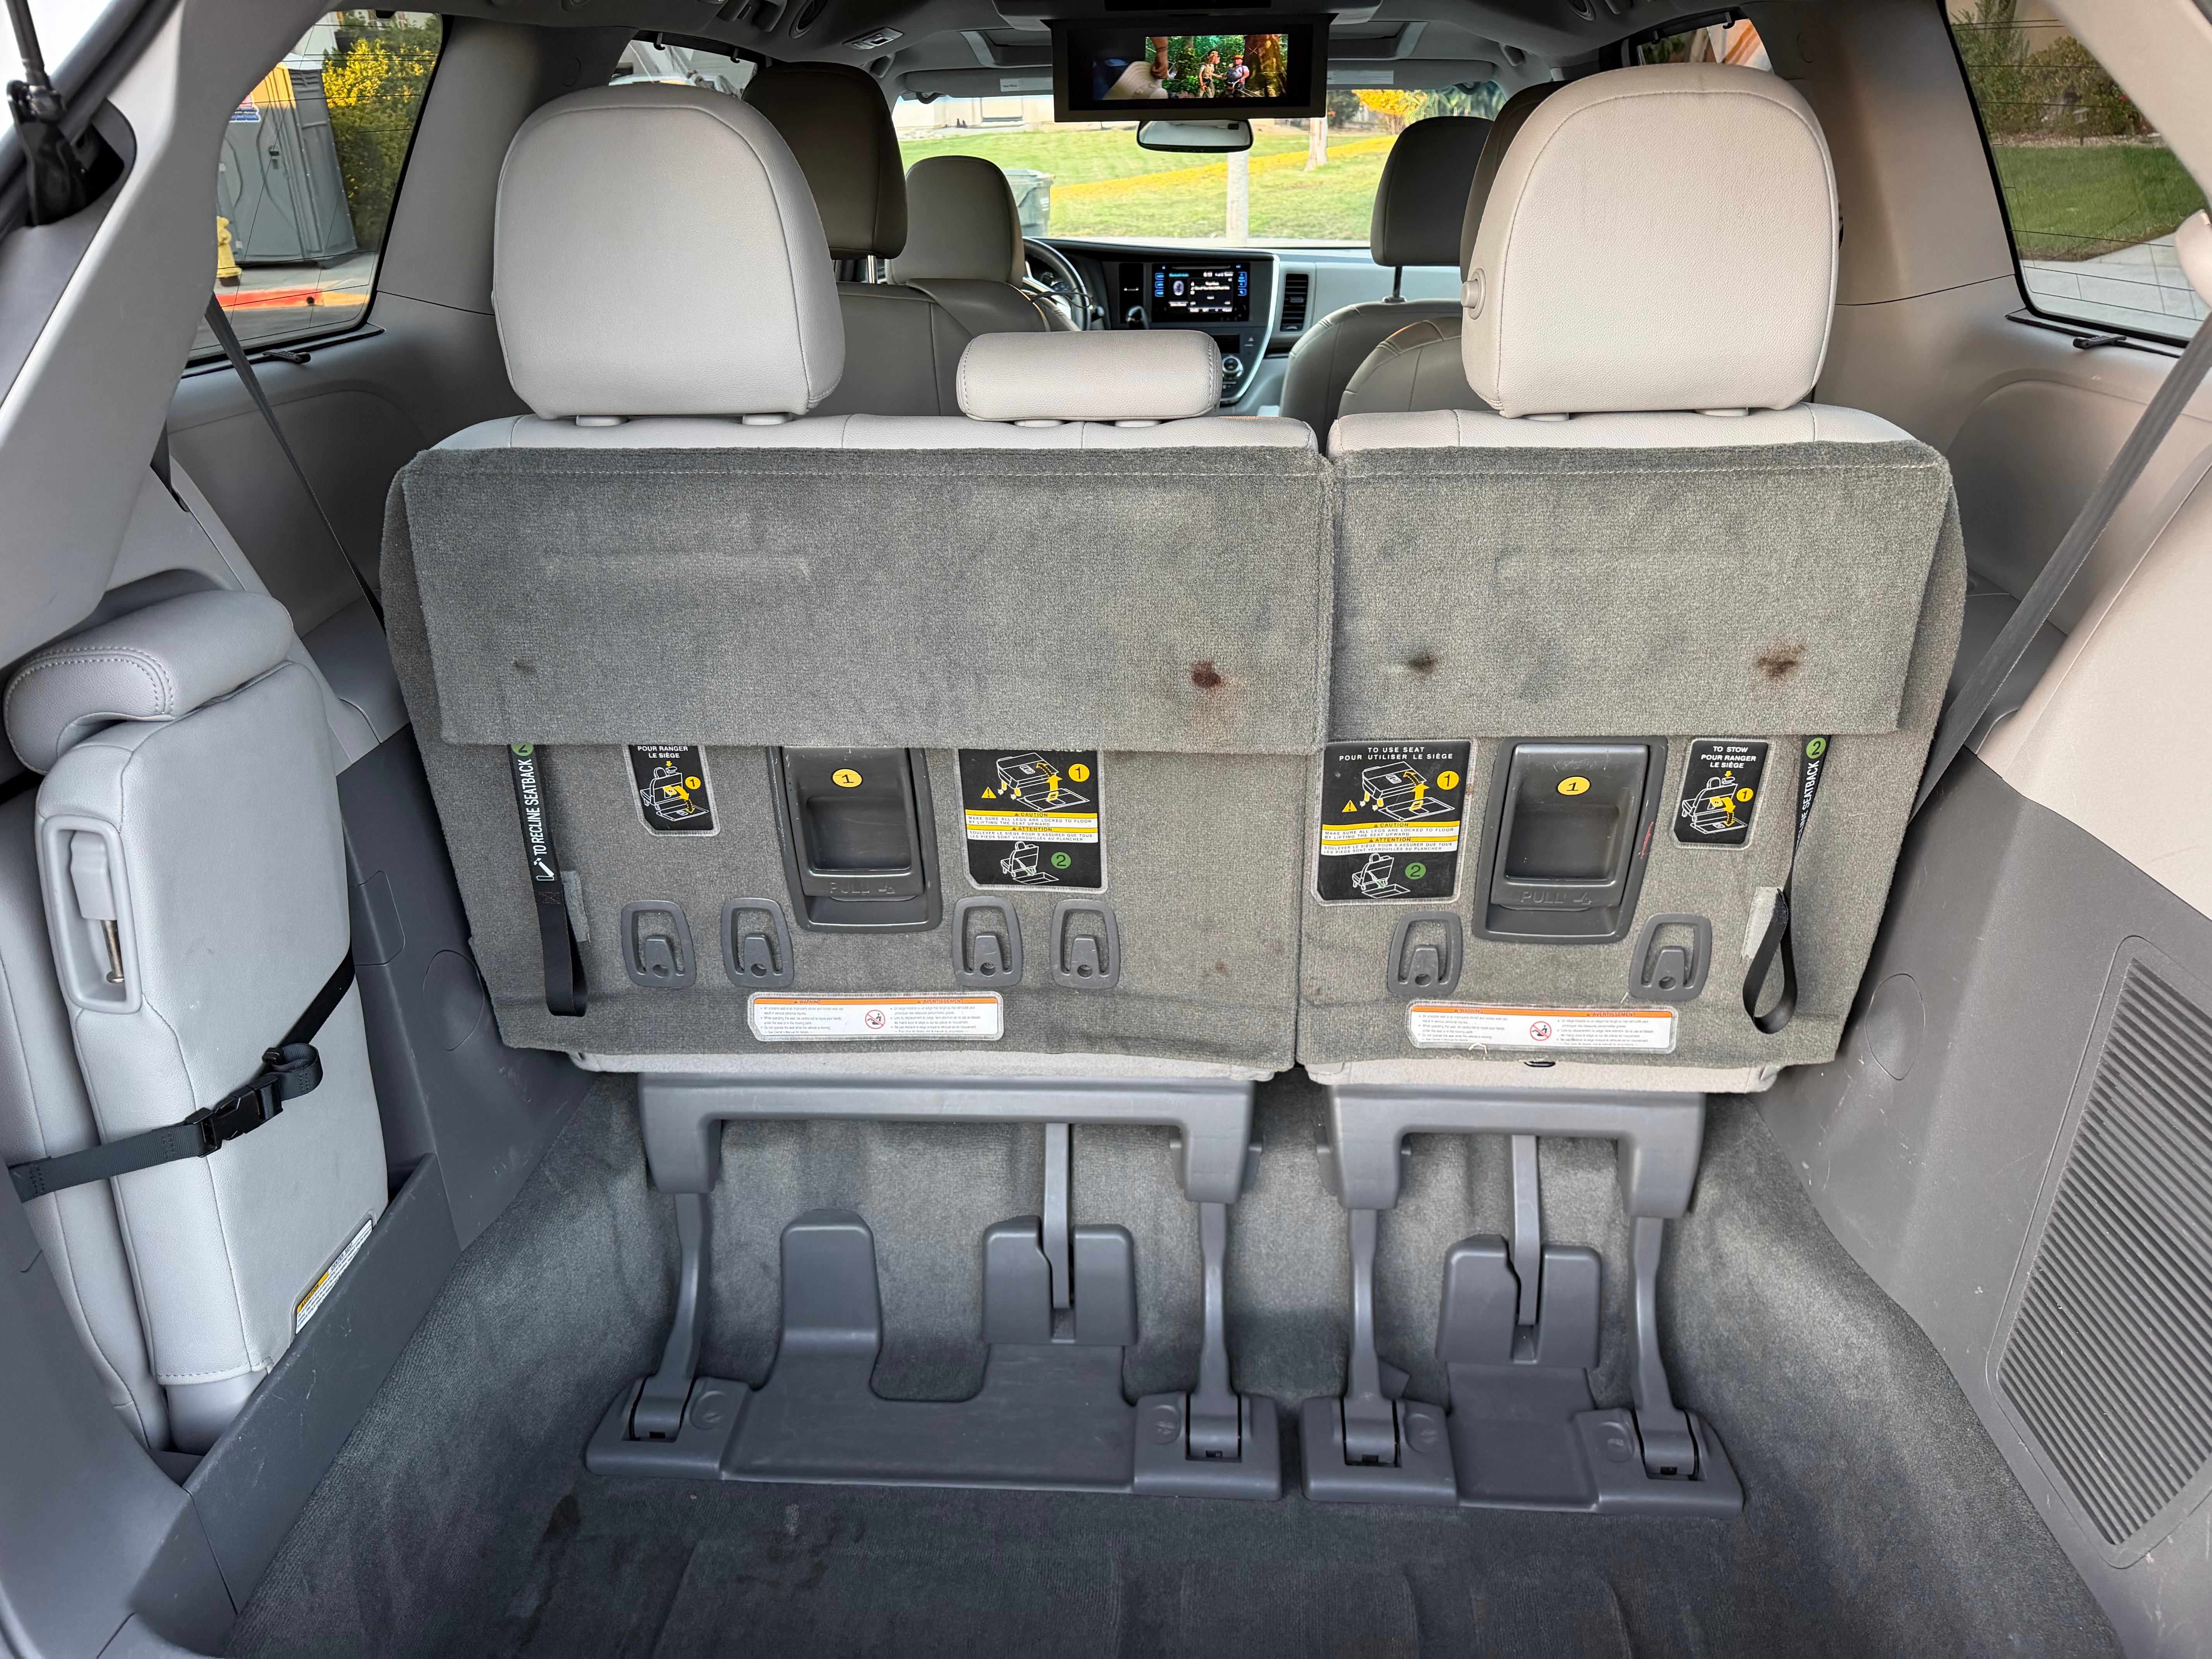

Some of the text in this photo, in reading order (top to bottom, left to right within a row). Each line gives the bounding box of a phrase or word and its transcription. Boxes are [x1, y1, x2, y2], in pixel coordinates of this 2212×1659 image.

[1811, 741, 1821, 755] 2
[1075, 766, 1082, 779] 1
[842, 774, 854, 784] 1
[1445, 774, 1451, 787] 1
[1802, 760, 1819, 810] SEATBACK
[1566, 782, 1579, 792] 1
[518, 759, 547, 855] TO RECLINE SEATBACK
[1056, 855, 1066, 866] 2
[1410, 865, 1421, 877] 2
[831, 882, 869, 894] PULL
[1520, 891, 1566, 904] PULL
[345, 1242, 353, 1254] SEAT
